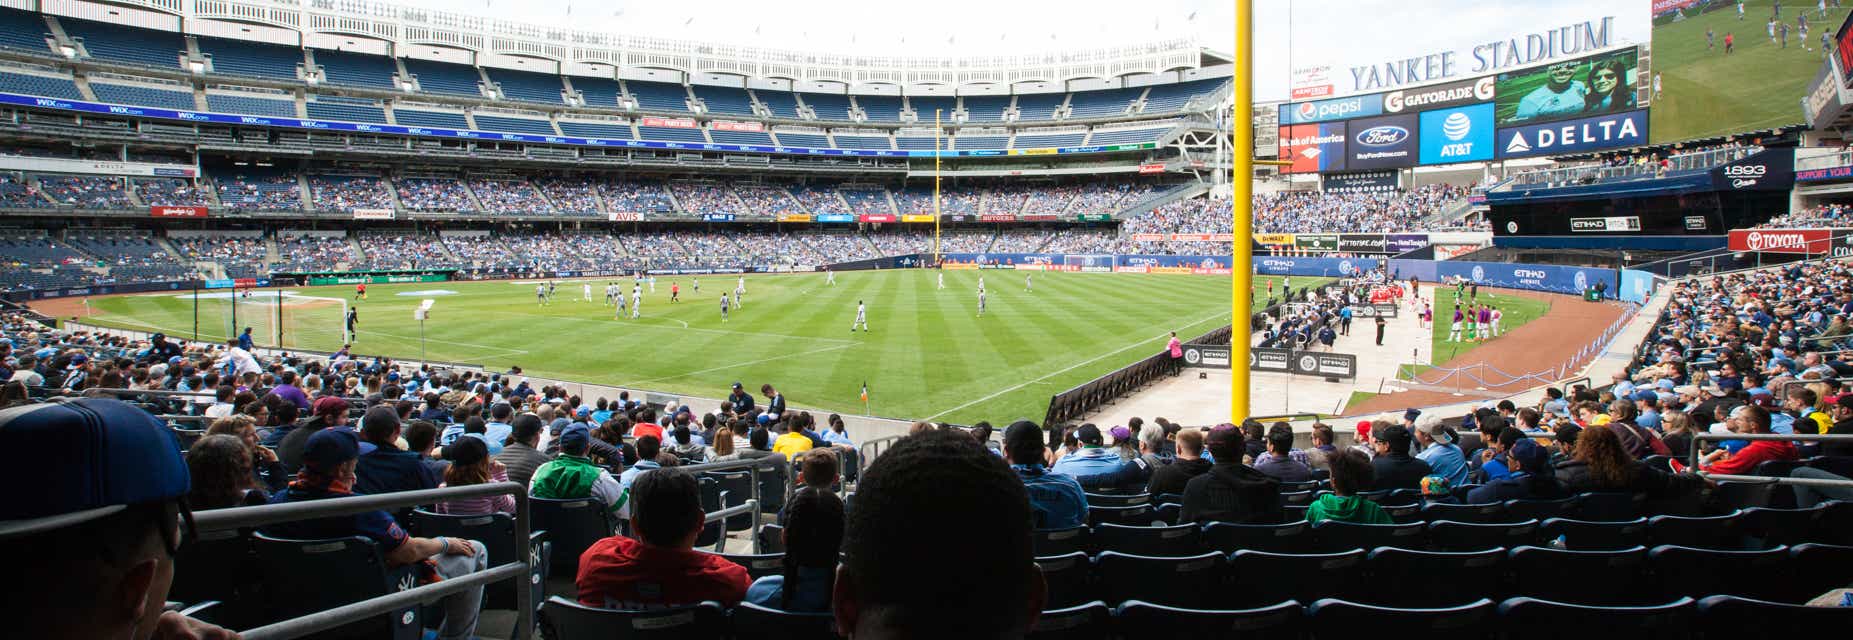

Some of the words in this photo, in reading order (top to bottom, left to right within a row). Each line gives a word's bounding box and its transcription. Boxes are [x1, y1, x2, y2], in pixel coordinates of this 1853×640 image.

[1350, 50, 1458, 91] YANKEE
[1472, 16, 1616, 72] STADIUM
[1405, 86, 1474, 107] GATORADE
[1319, 98, 1361, 118] pepsi
[1366, 128, 1398, 144] Ford
[1538, 117, 1638, 148] DELTA
[1280, 136, 1301, 147] Bank
[1302, 135, 1310, 145] of
[1310, 134, 1345, 145] America
[1356, 151, 1408, 160] BuyFordNow.com
[1440, 142, 1473, 157] AT&T
[1724, 165, 1767, 175] 1893
[1796, 170, 1827, 180] SUPPORT
[1830, 167, 1852, 177] YOUR
[615, 213, 638, 221] AVIS
[1763, 234, 1806, 249] TOYOTA
[1514, 269, 1546, 279] ETIHAD
[1321, 359, 1348, 367] ETIHAD
